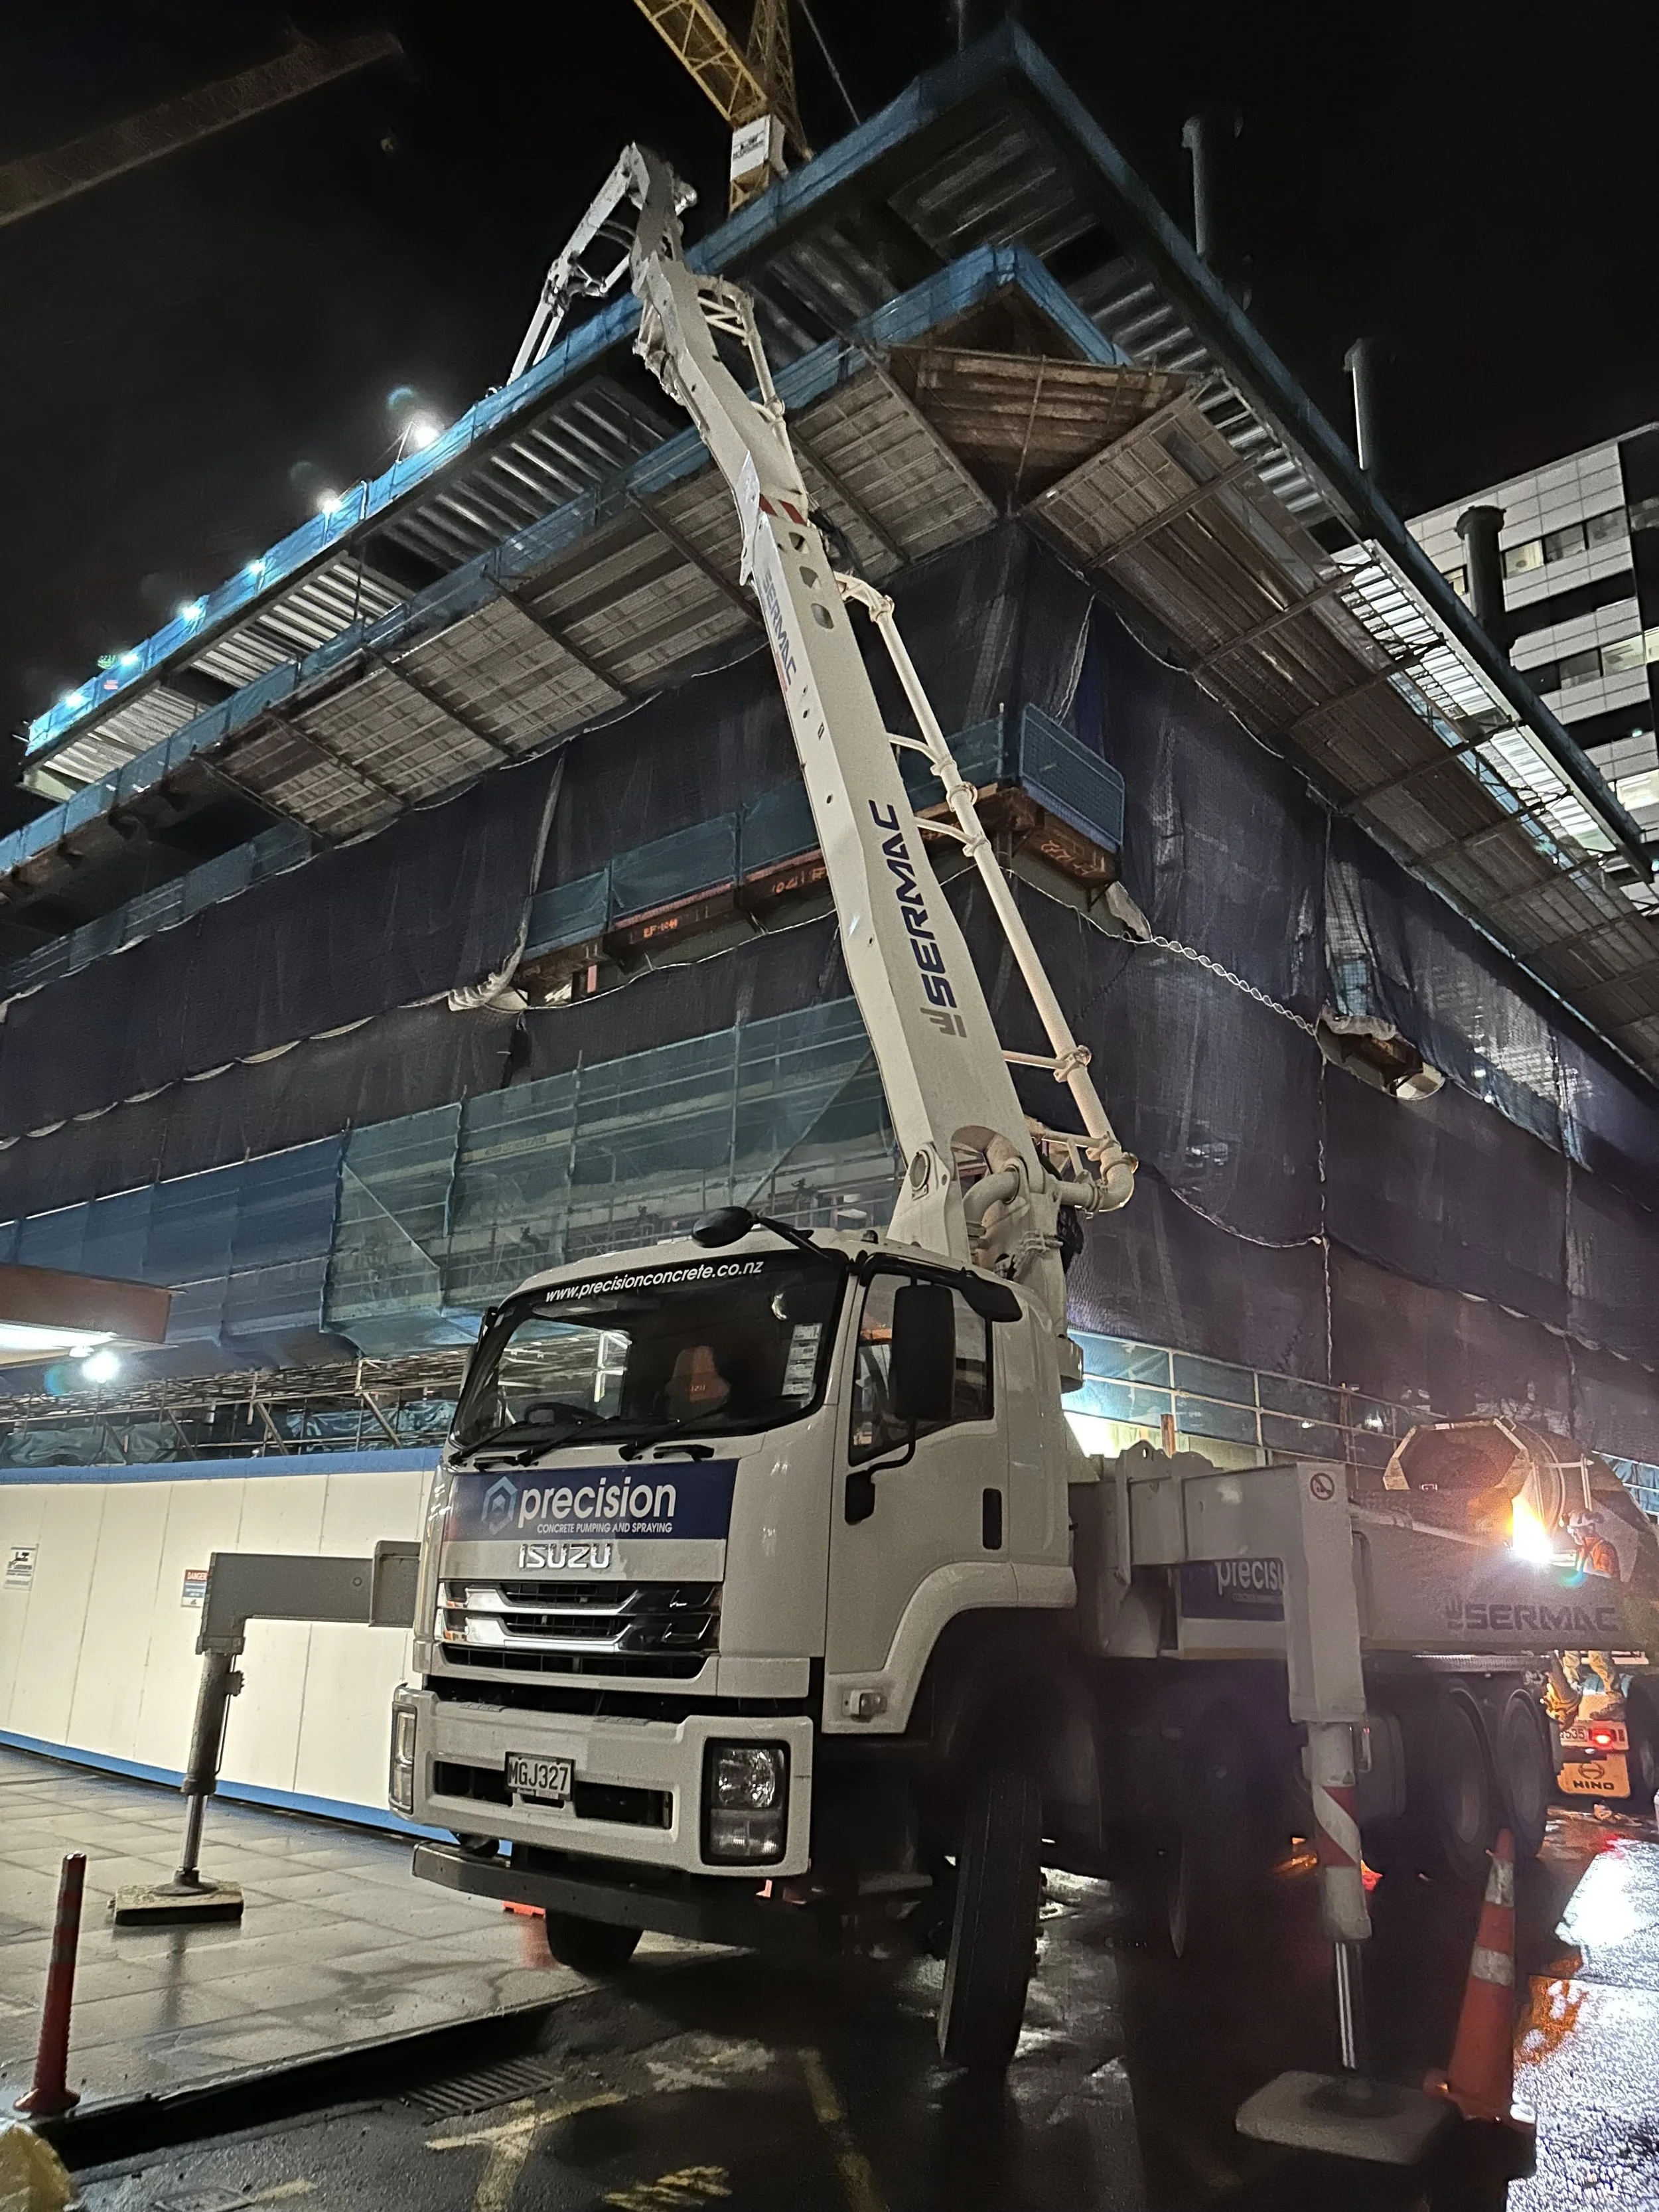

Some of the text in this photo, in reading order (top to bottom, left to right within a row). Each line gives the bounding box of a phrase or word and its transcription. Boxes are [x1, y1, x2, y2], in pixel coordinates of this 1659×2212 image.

[764, 569, 796, 686] SERMAC
[869, 800, 957, 1008] SERMAC
[545, 1261, 764, 1303] www.precisionconcrete.co.nz
[518, 1476, 677, 1529] precision
[537, 1522, 673, 1534] CONCRETE PUMPING AND SPRAYING
[518, 1542, 613, 1569] ISUZU
[1465, 1603, 1619, 1632] SERMAC
[508, 1760, 569, 1791] MGJ327
[1573, 1780, 1615, 1791] HINO
